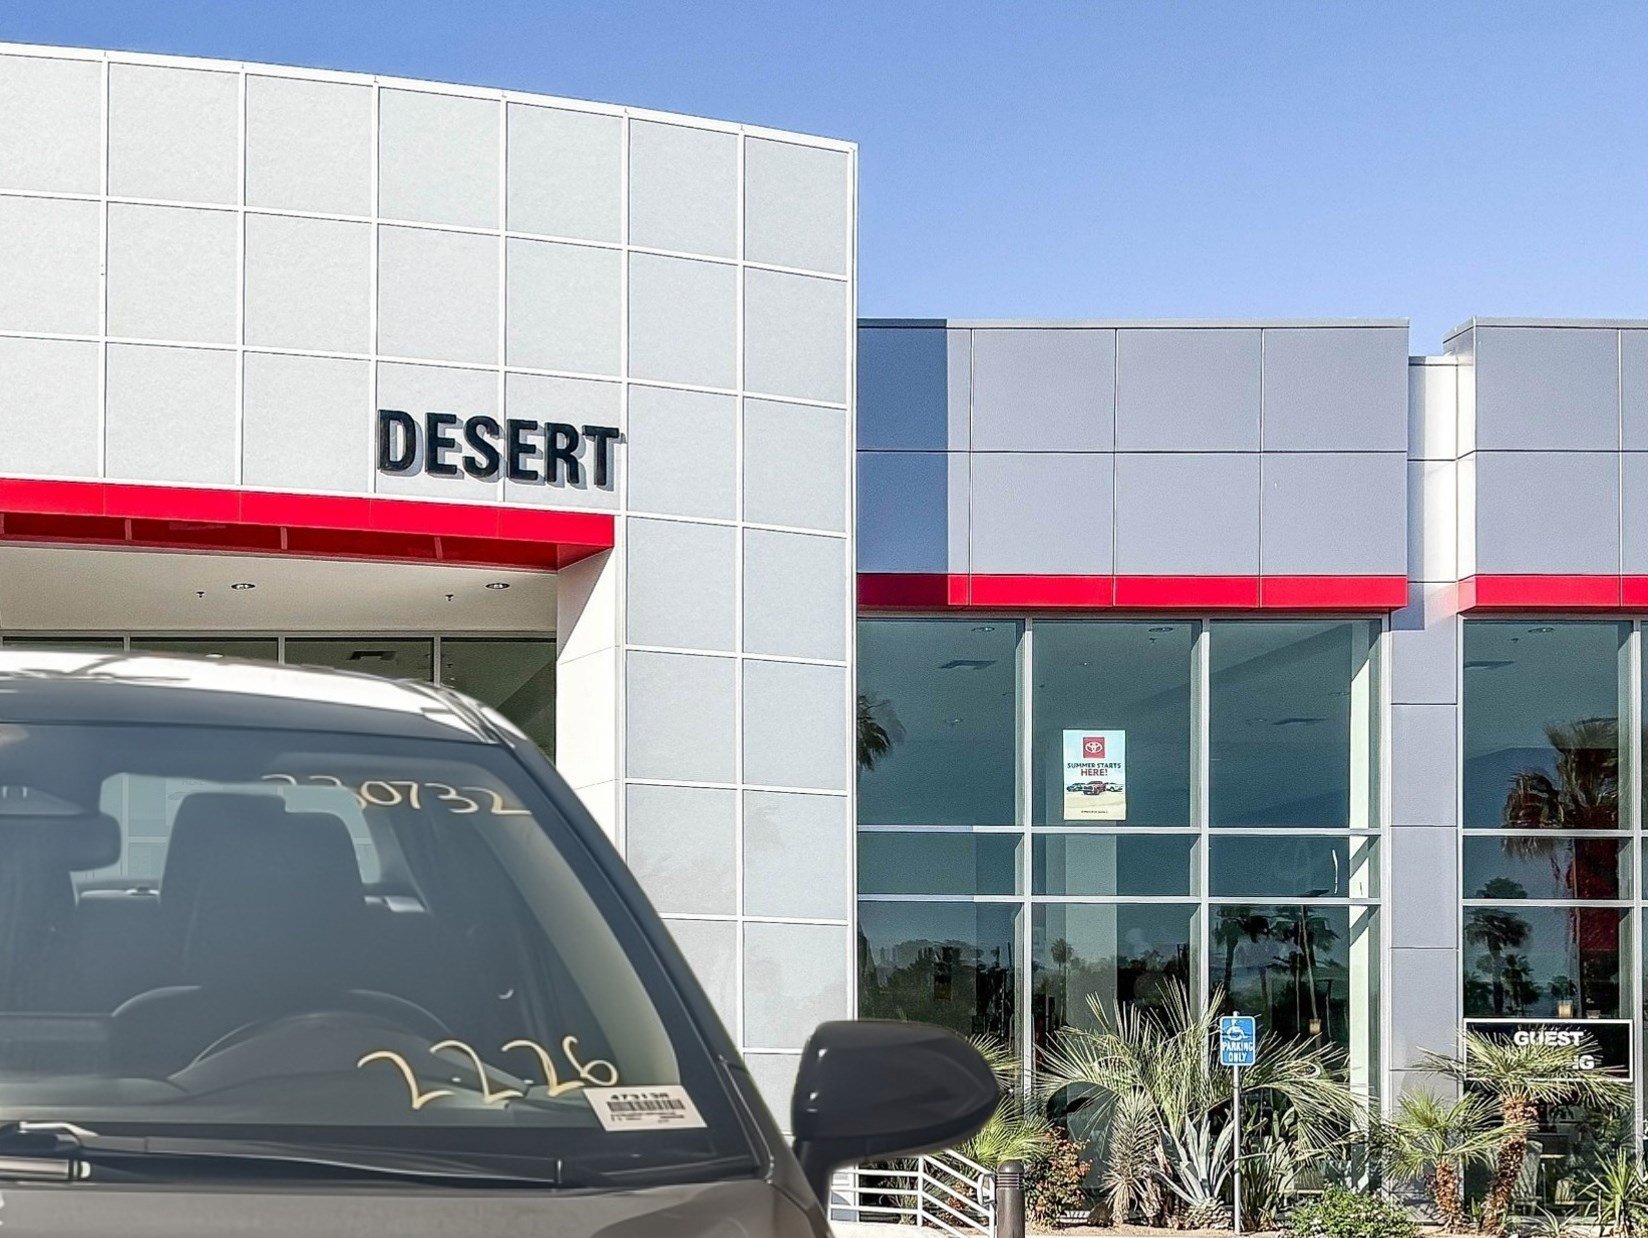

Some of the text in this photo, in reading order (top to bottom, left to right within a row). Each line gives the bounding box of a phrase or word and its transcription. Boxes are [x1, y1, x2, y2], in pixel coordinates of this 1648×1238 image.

[377, 409, 620, 486] DESERT
[1080, 768, 1108, 776] HERE!
[1513, 1031, 1584, 1046] GUEST
[1222, 1041, 1253, 1052] PARKING
[1228, 1051, 1247, 1063] ONLY
[357, 1036, 618, 1110] 2226
